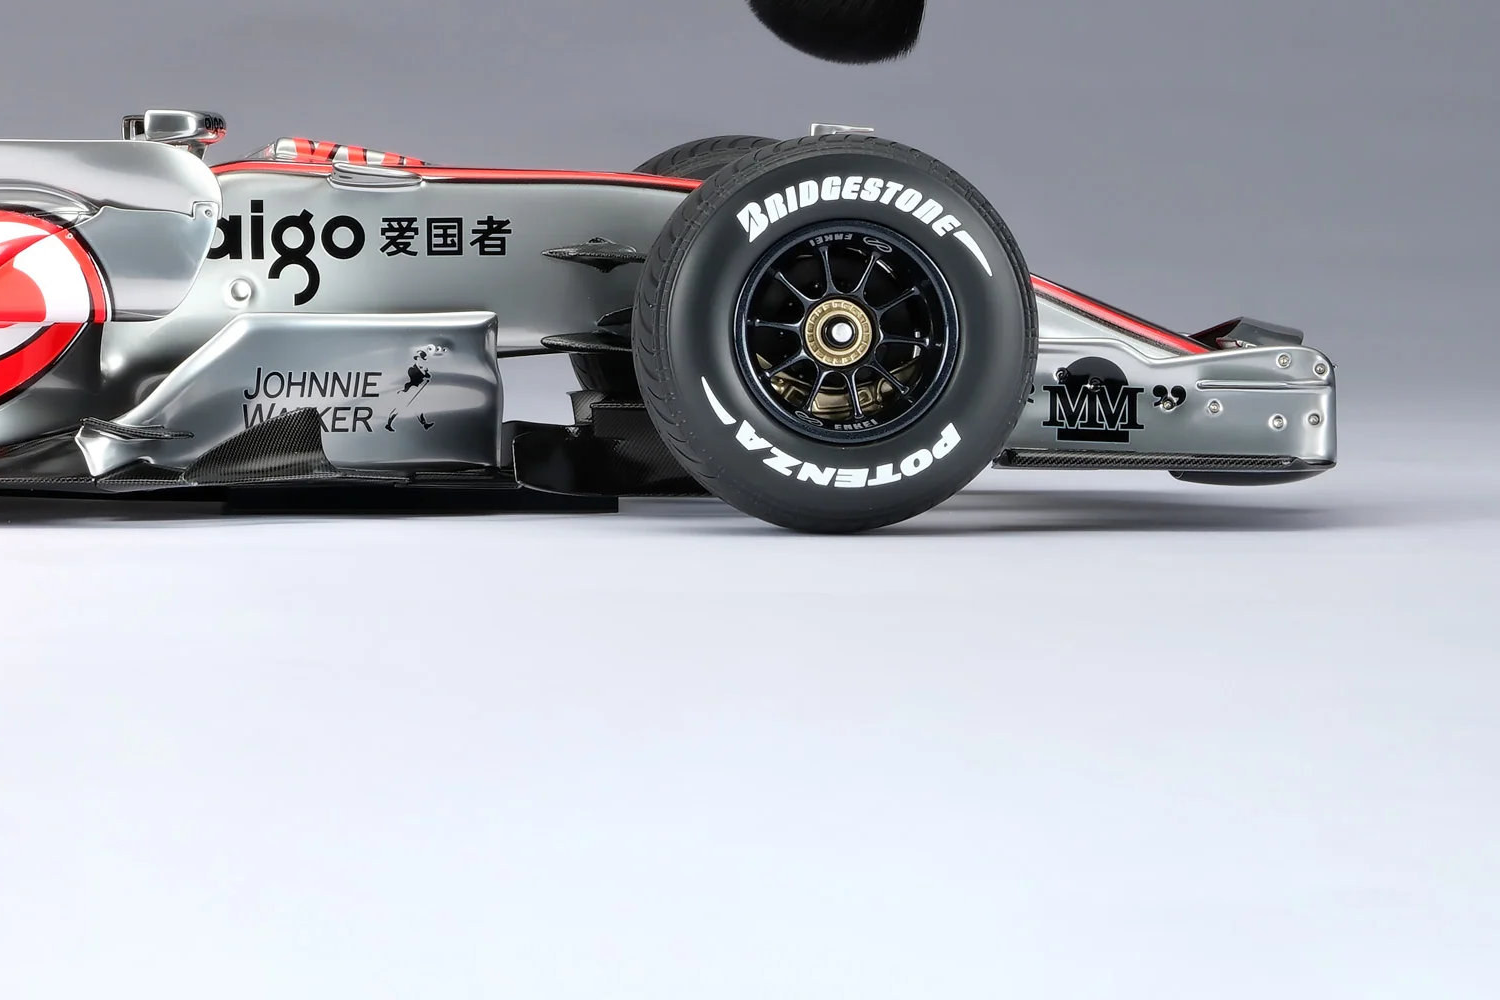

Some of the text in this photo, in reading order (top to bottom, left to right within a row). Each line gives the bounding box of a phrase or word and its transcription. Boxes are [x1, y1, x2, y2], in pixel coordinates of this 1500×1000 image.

[379, 215, 513, 257] 爱国者
[736, 175, 960, 243] BRIDGESTONE
[205, 199, 366, 306] aigo
[243, 366, 383, 400] JOHNNIE
[242, 402, 374, 433] WKER
[734, 422, 963, 488] POTENZA
